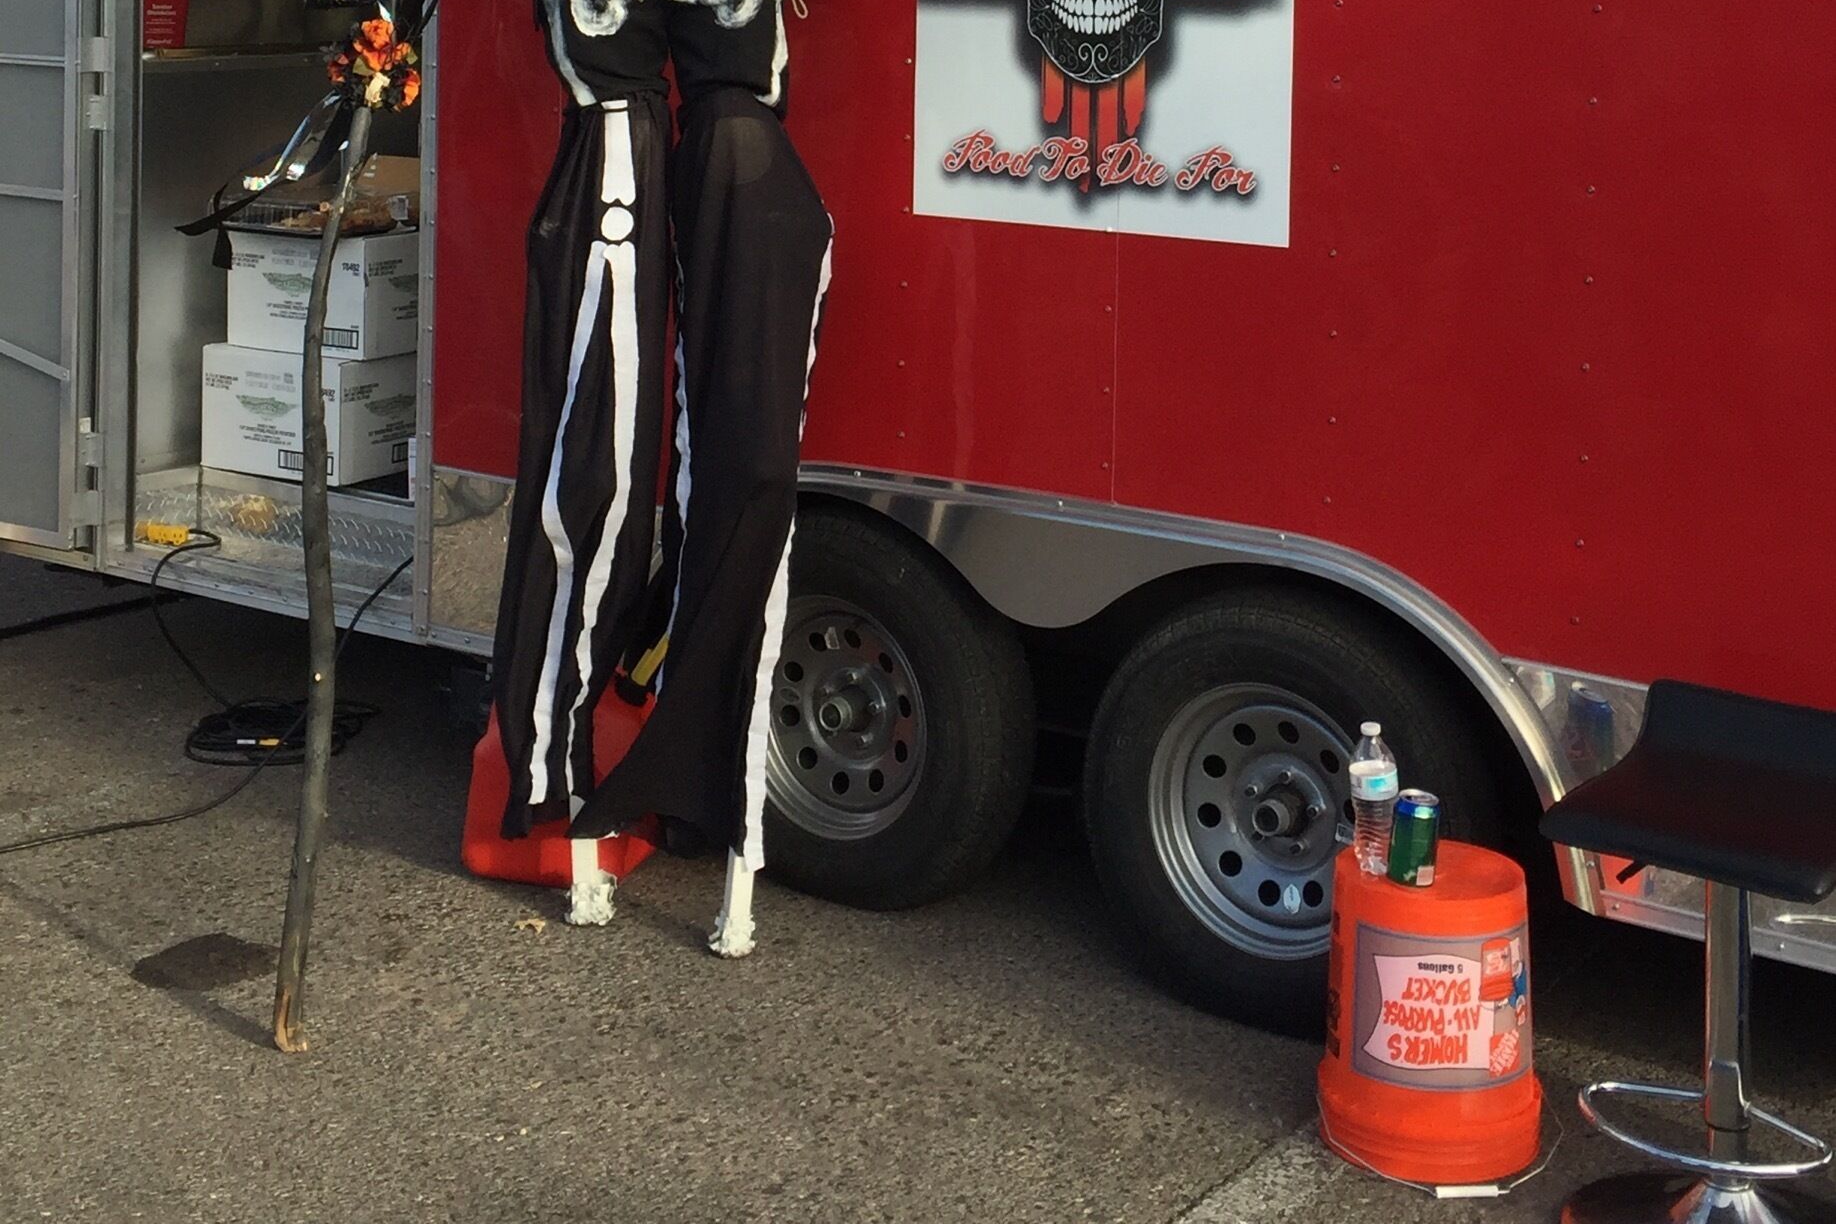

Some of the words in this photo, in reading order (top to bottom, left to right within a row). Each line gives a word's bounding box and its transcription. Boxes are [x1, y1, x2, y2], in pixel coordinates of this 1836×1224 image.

[943, 129, 1041, 178] Food
[1039, 136, 1090, 181] To
[1097, 137, 1168, 187] Die
[1174, 145, 1257, 195] For
[1417, 962, 1455, 974] Gallons
[1401, 977, 1472, 1006] BUCKET
